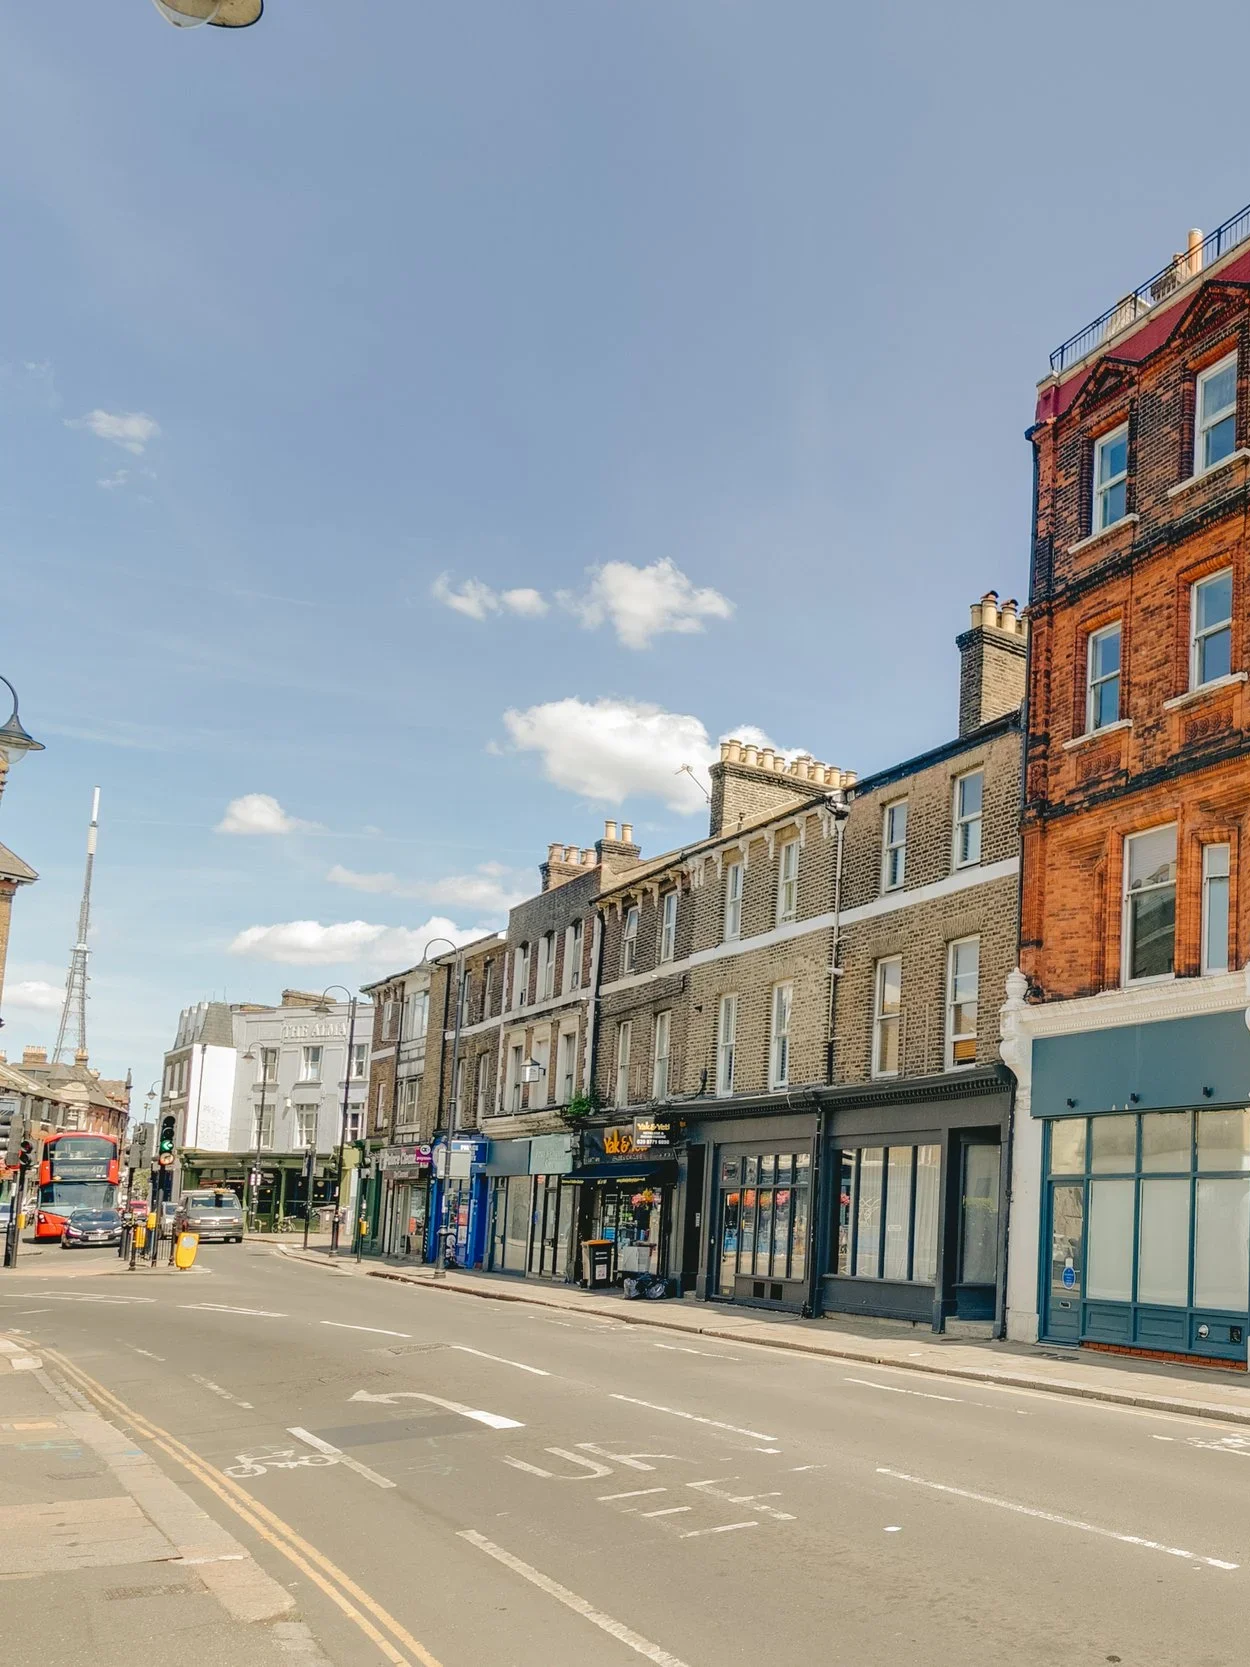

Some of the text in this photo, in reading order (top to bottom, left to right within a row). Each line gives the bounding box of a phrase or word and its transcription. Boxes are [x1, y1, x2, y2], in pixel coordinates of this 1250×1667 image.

[283, 1022, 347, 1038] THE ALMA
[637, 1121, 650, 1131] Yak
[603, 1129, 620, 1154] Yak
[621, 1135, 630, 1153] &
[90, 1165, 104, 1173] 417
